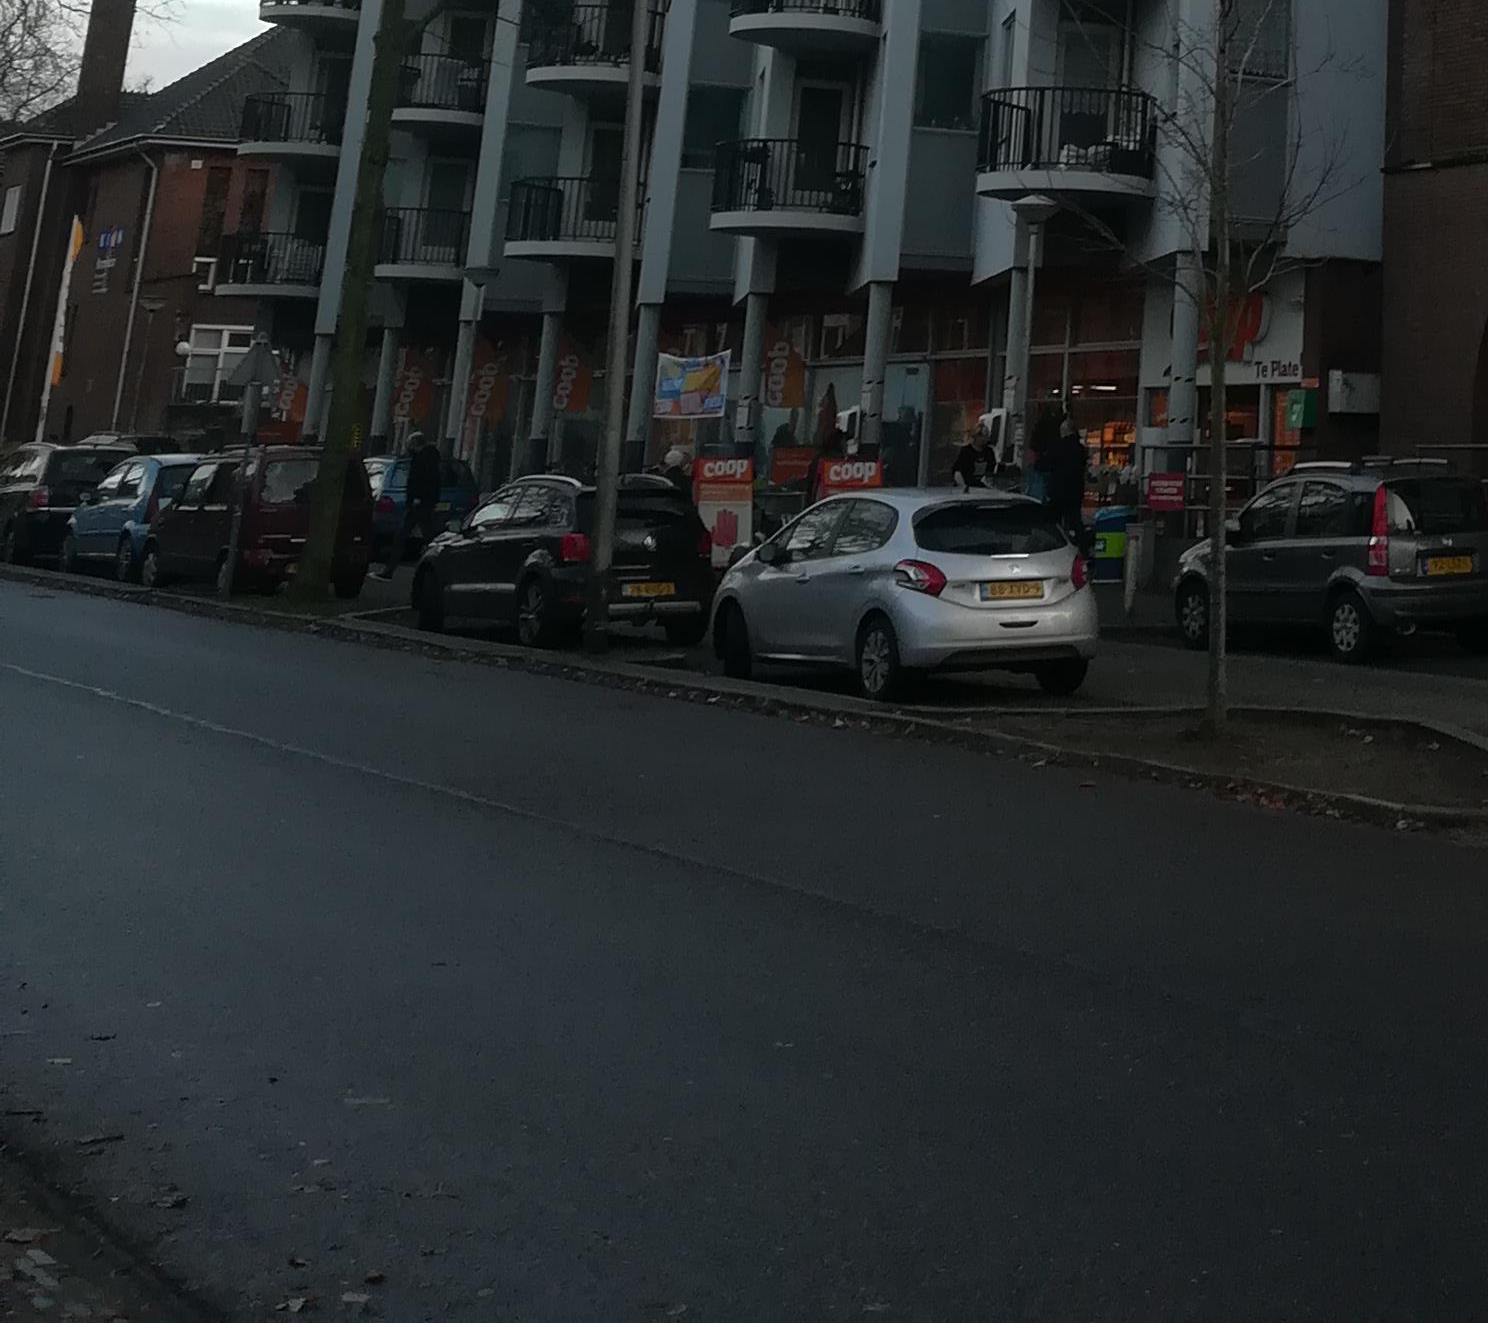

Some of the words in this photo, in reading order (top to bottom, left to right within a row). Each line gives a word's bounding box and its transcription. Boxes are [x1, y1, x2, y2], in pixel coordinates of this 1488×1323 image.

[1255, 361, 1268, 378] Te
[1271, 360, 1299, 377] Plate
[703, 459, 748, 478] coop
[829, 461, 876, 482] coop
